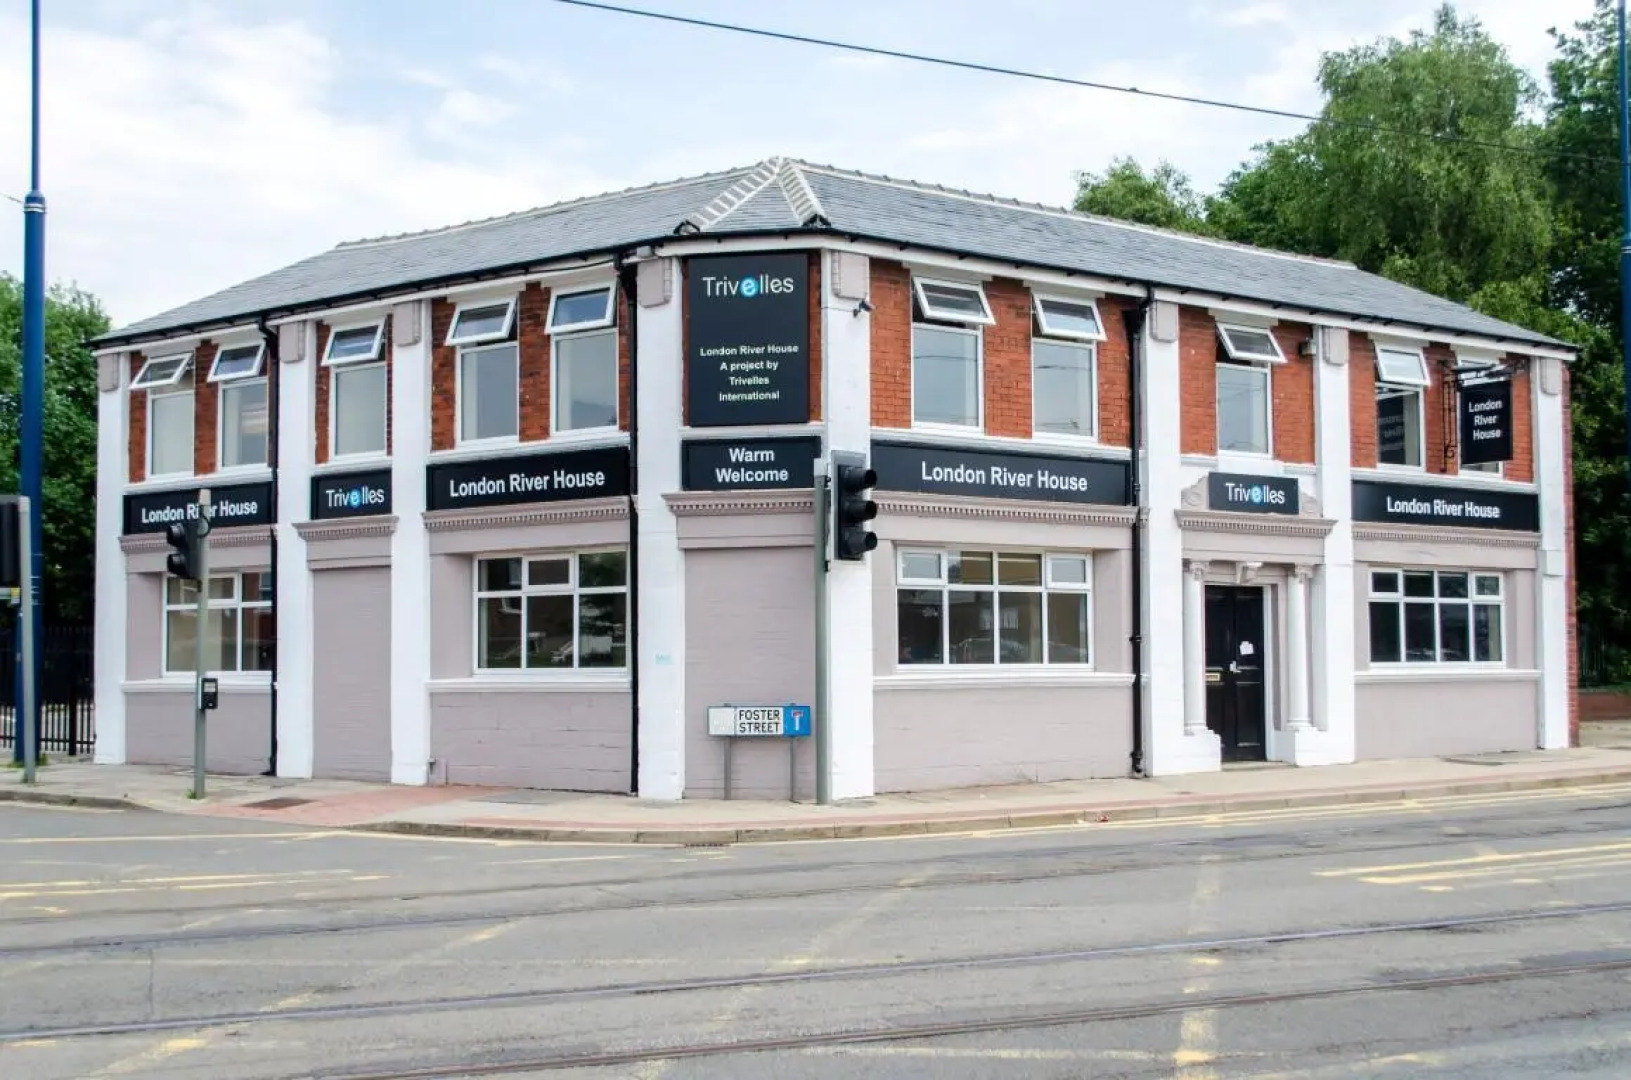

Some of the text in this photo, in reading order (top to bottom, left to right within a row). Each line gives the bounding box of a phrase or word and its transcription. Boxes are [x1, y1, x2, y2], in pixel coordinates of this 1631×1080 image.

[702, 273, 794, 297] Trivelles
[700, 344, 799, 357] London River House
[719, 359, 779, 372] A project by
[729, 376, 770, 386] Trivelles
[719, 391, 780, 402] International
[1468, 399, 1503, 413] London
[1474, 415, 1497, 426] River
[1472, 428, 1501, 440] House
[729, 448, 775, 462] Warm
[715, 467, 789, 482] Welcome
[921, 461, 1088, 491] London River House
[450, 469, 605, 498] London River House
[325, 485, 385, 508] Trivelles
[1225, 482, 1285, 504] Trivelles
[141, 500, 258, 523] London Rier House
[1387, 497, 1500, 518] London River House
[739, 709, 780, 721] FOSTER
[739, 722, 780, 733] STREET
